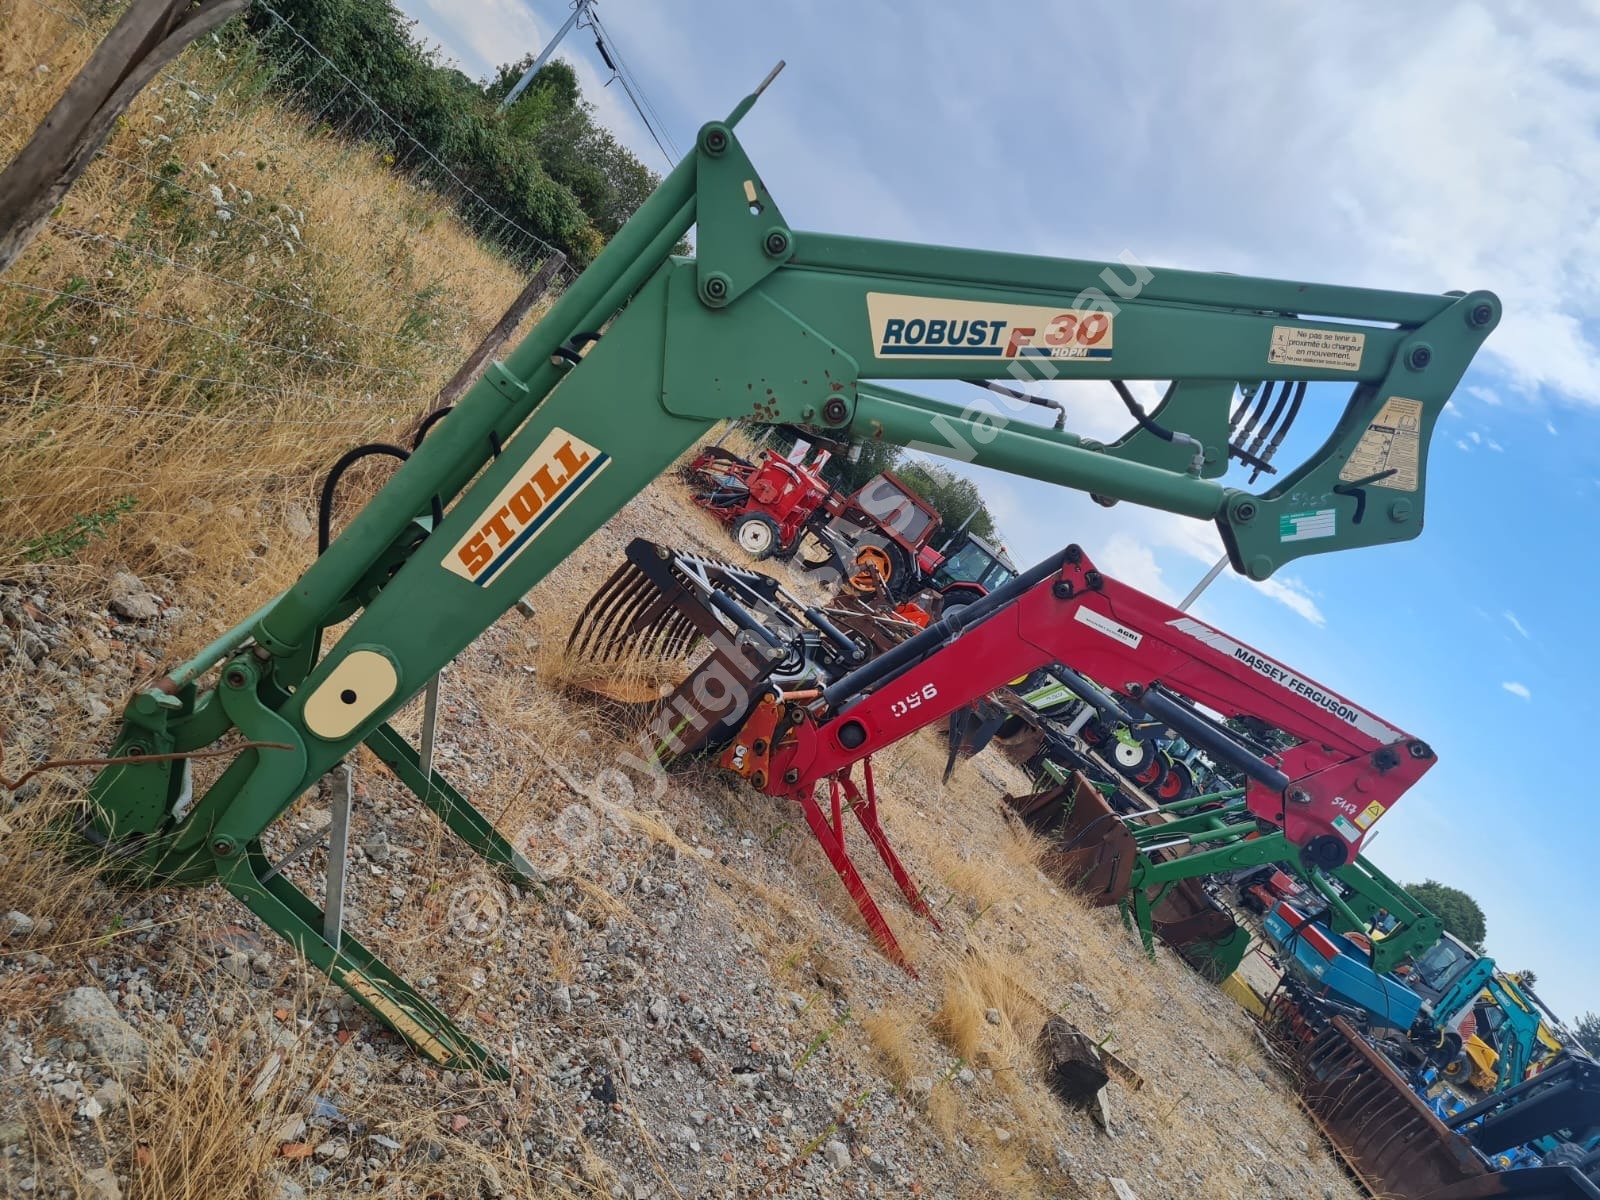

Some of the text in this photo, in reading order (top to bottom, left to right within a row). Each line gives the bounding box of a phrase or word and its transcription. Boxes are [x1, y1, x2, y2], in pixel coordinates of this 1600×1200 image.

[883, 313, 1109, 358] ROBUST F 30
[1051, 348, 1088, 357] HDPM
[458, 440, 590, 576] STOLL
[1117, 628, 1138, 641] AGRI
[1234, 648, 1359, 724] MASSEY FERGUSON
